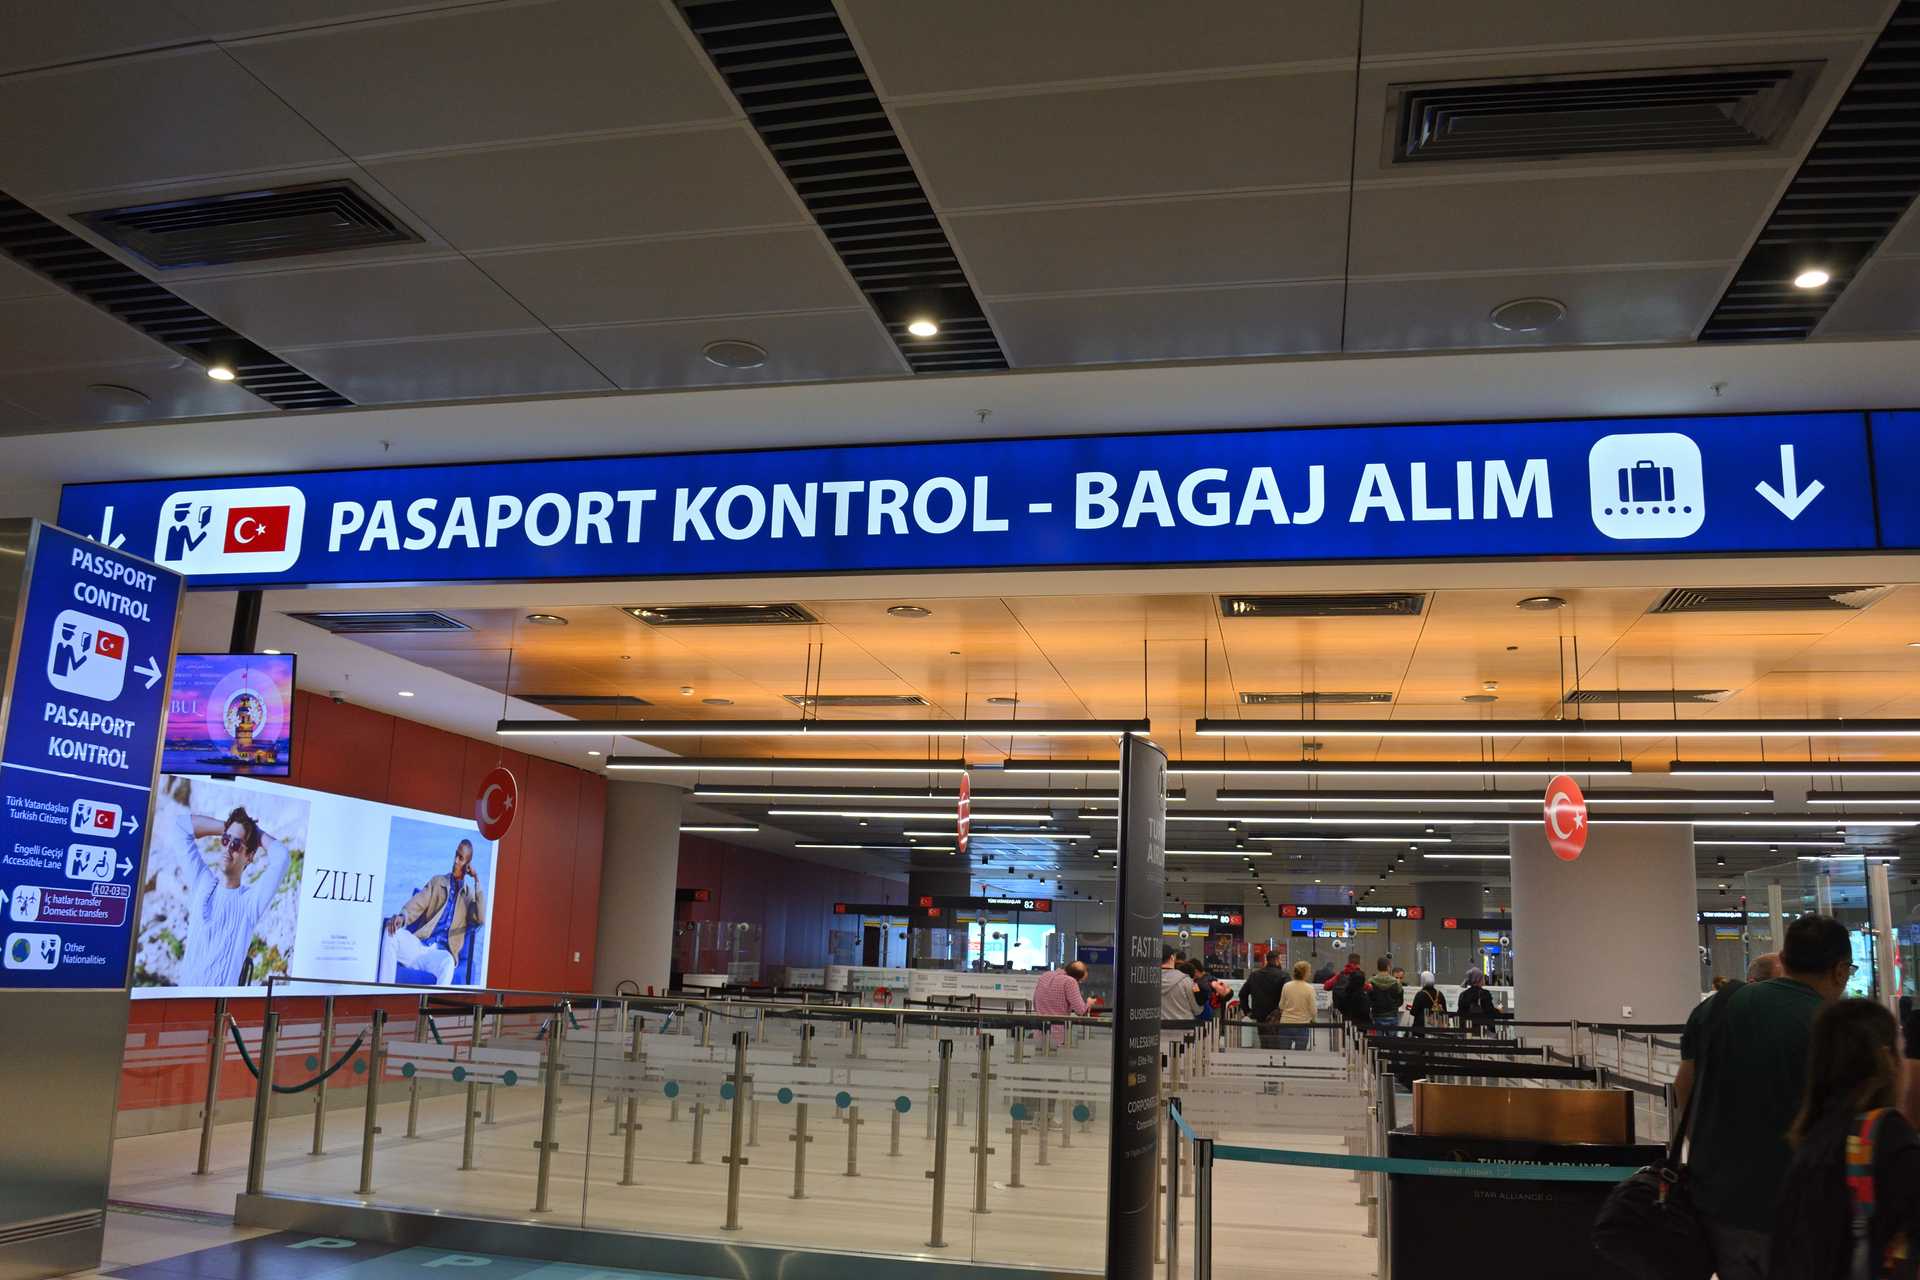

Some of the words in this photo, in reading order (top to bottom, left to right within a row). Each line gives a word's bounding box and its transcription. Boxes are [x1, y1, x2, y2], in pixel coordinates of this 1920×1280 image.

[328, 489, 657, 551] PASAPORT
[673, 476, 1009, 542] KONTROL
[1029, 503, 1052, 513] -
[1075, 465, 1325, 530] BAGAJ
[1349, 458, 1553, 523] ALIM
[72, 547, 156, 593] PASSPORT
[73, 582, 151, 623] CONTROL
[44, 702, 135, 739] PASAPORT
[48, 736, 129, 770] KONTROL
[6, 795, 23, 807] Türk
[10, 808, 38, 821] Turkish
[39, 812, 68, 824] Citizens
[14, 843, 41, 856] Engelli
[2, 854, 43, 868] Accessible
[43, 858, 62, 870] Lane
[313, 868, 375, 903] ZILLI
[53, 893, 74, 905] hatlar
[75, 896, 102, 907] transfer
[1024, 900, 1034, 909] 82
[43, 905, 77, 917] Domestic
[78, 908, 109, 919] transfers
[1297, 906, 1308, 915] 79
[1396, 908, 1407, 917] 78
[64, 942, 86, 952] Other
[1131, 935, 1151, 958] FAST
[62, 954, 107, 965] Nationalities
[1474, 1190, 1498, 1200] STAR
